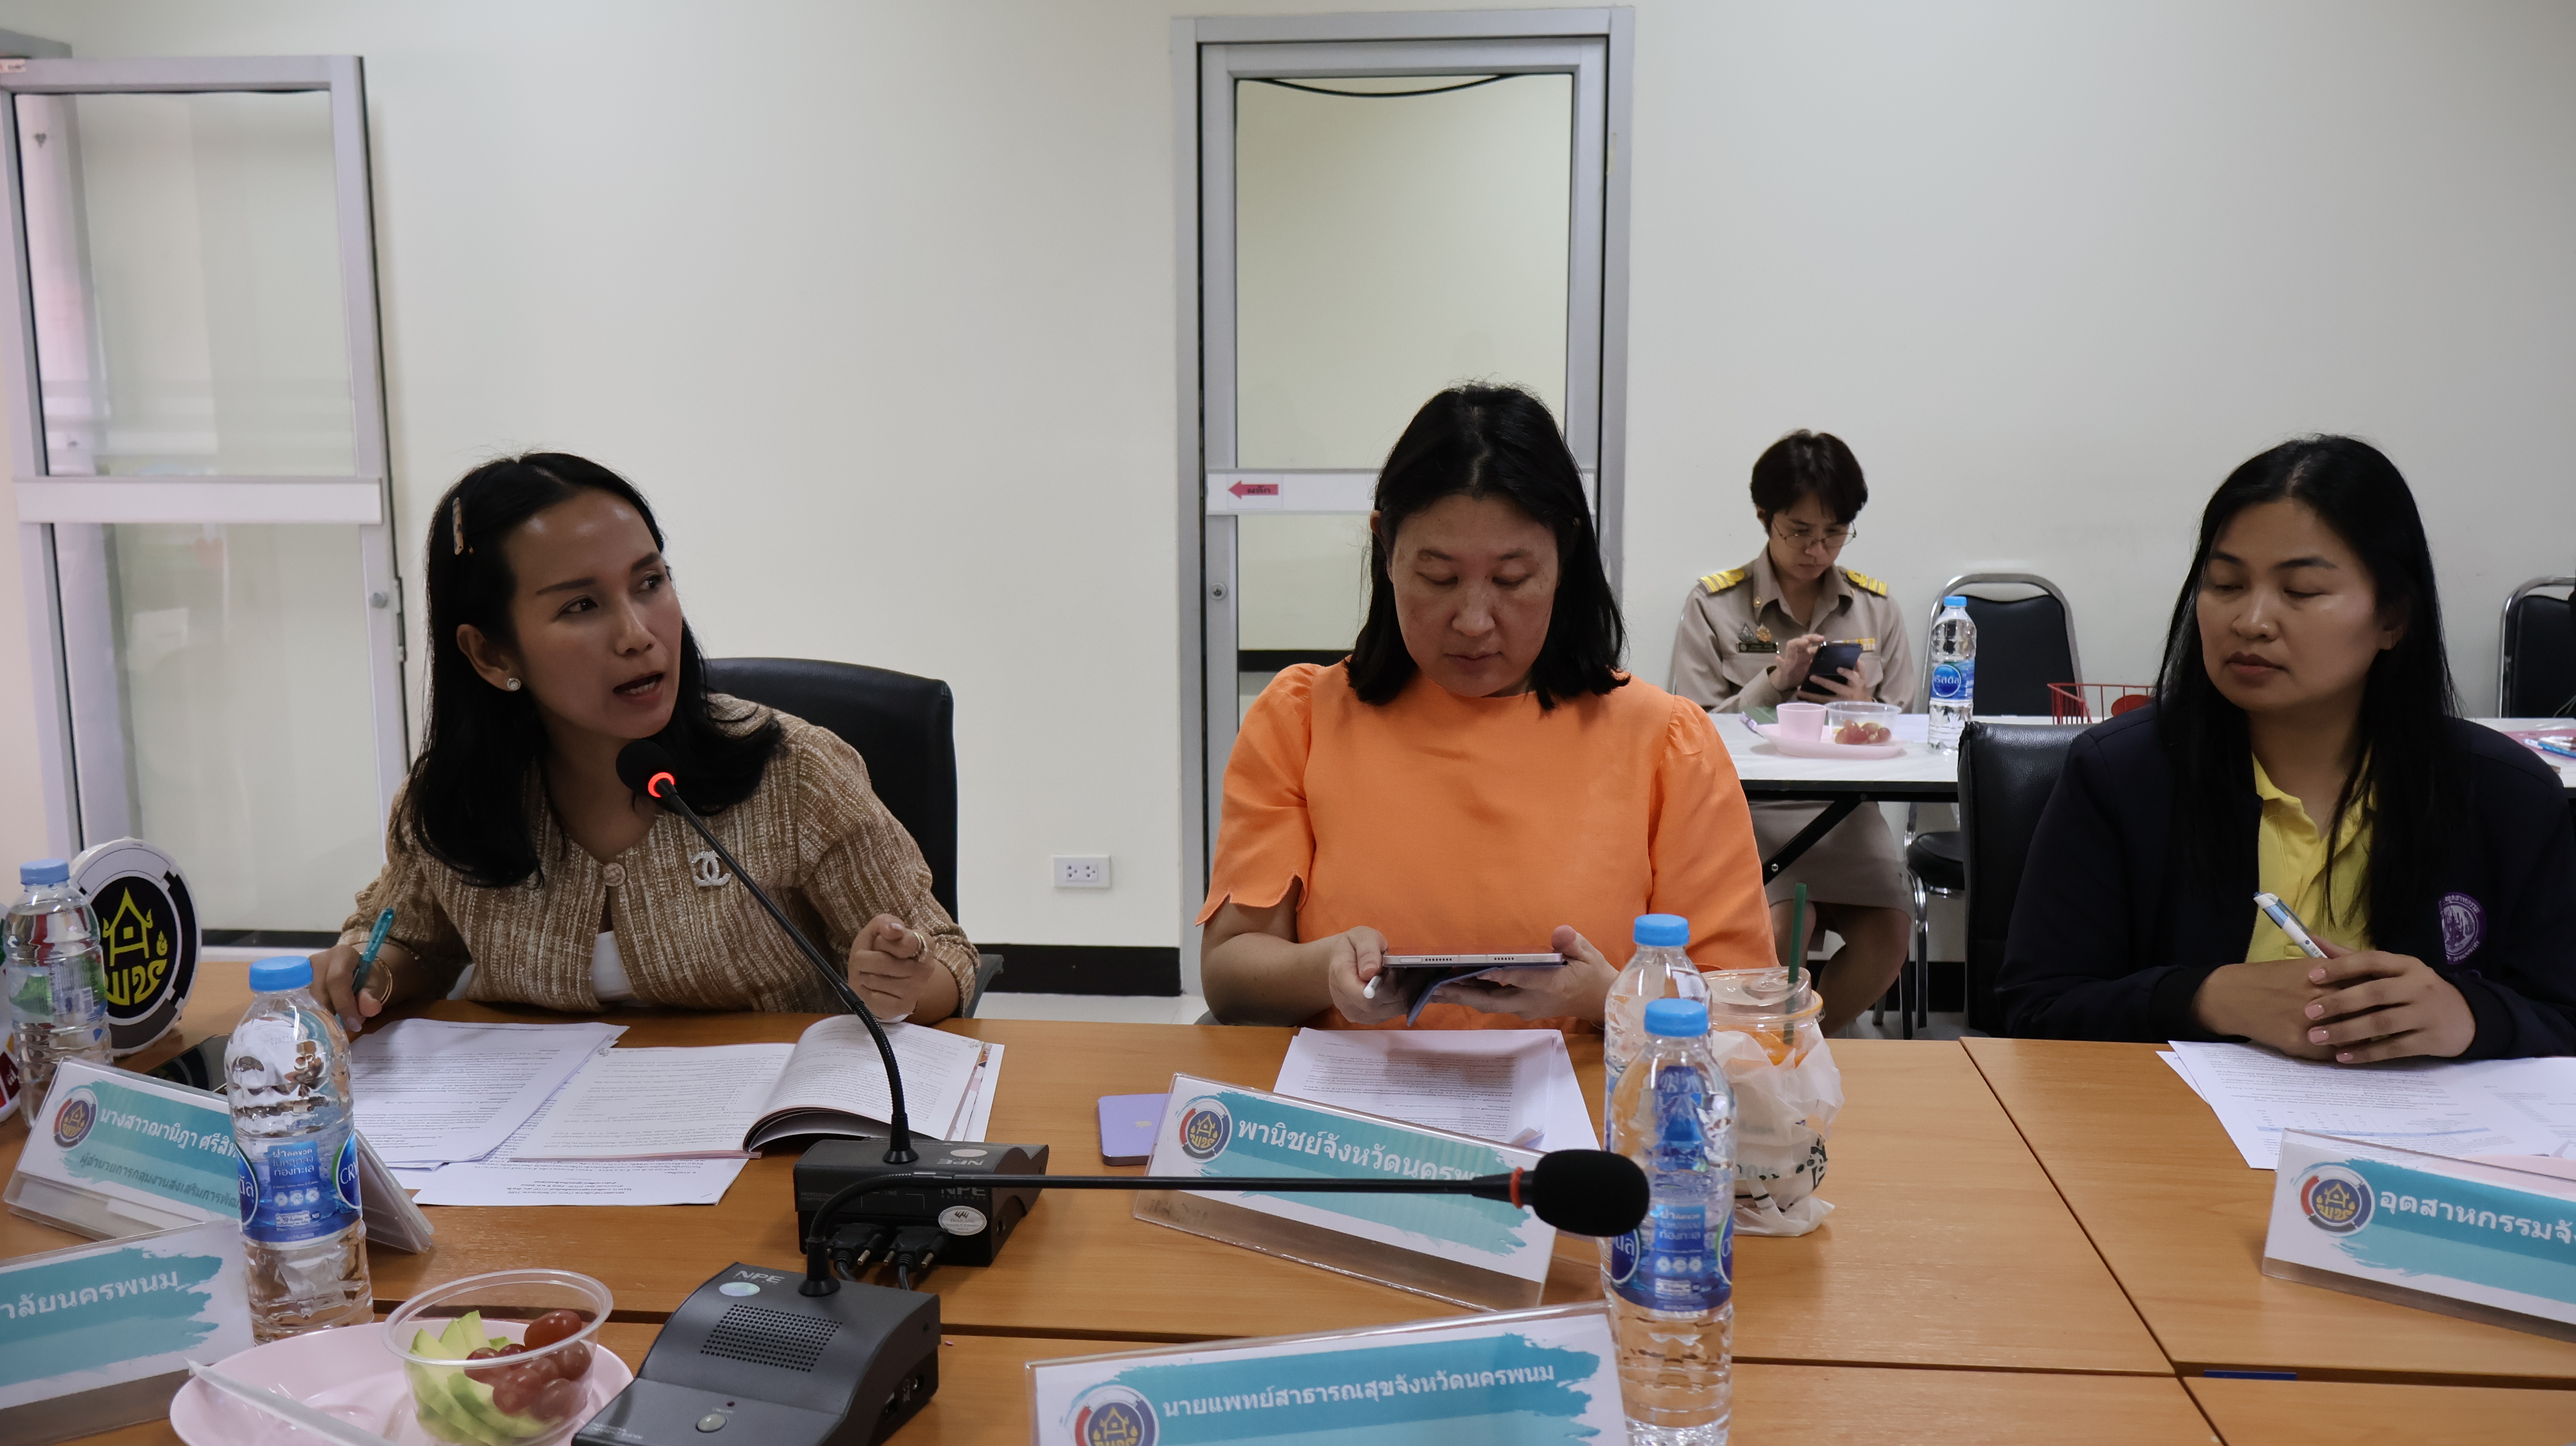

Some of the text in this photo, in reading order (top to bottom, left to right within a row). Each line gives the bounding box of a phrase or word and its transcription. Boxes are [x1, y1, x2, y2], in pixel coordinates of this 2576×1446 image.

[2380, 1191, 2576, 1244] อุตสาหกรรมจั
[735, 1270, 785, 1283] NPE
[1161, 1364, 1555, 1419] นายแพทย์สาธารณสุขจังหวัดนครพนม
